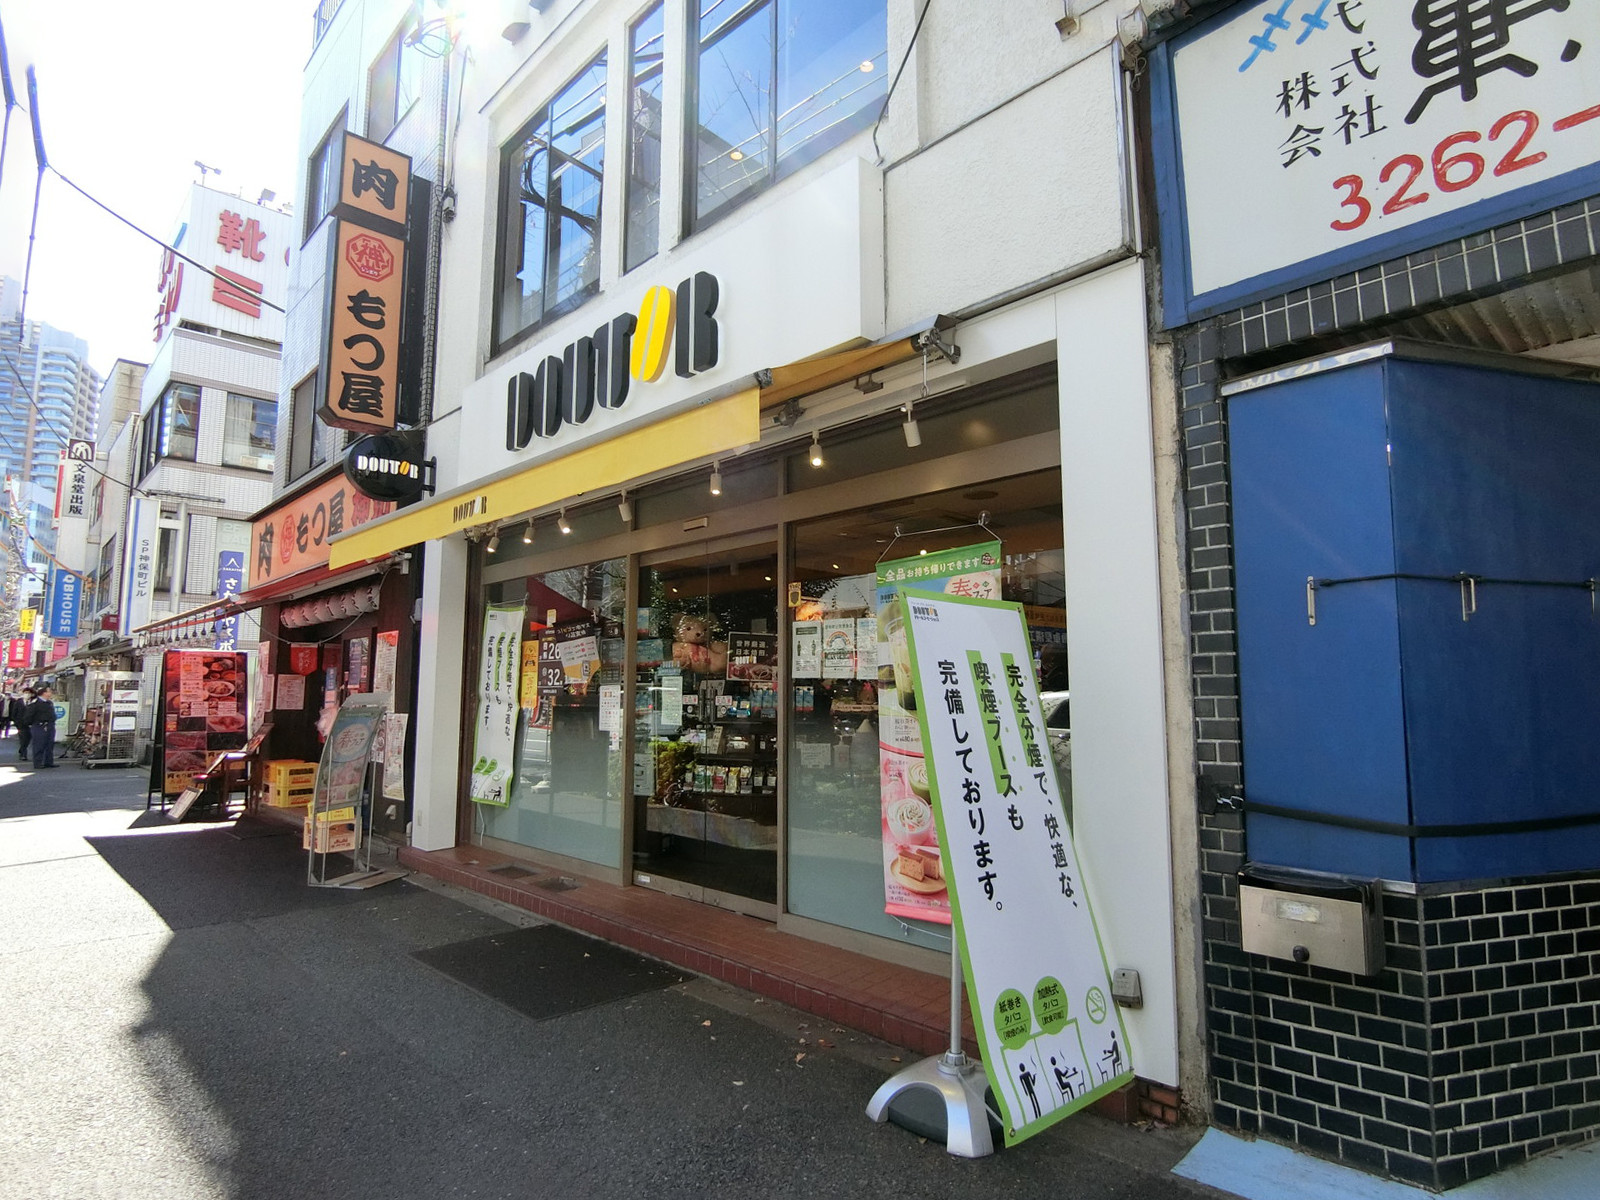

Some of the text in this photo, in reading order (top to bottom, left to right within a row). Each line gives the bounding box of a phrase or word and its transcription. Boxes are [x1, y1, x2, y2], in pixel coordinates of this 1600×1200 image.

[352, 159, 399, 210] 肉
[338, 289, 386, 418] もつ屋
[506, 270, 721, 452] DOUTOR
[68, 462, 86, 516] 文泉堂出版
[357, 455, 419, 480] DOUTOR
[296, 488, 346, 554] もつ屋
[453, 495, 488, 524] DOUTOR
[135, 539, 150, 597] SP神保町ビル
[885, 556, 980, 582] 全品お持ち帰りできます
[974, 660, 1025, 831] 喫煙ブースも
[937, 659, 1003, 911] 完備しております。
[1006, 663, 1078, 908] 完全分煙で、快適な、
[998, 996, 1021, 1014] 紙巻き
[1037, 983, 1060, 1000] 加熱式
[1042, 998, 1059, 1012] タバコ
[1004, 1012, 1022, 1026] タバコ
